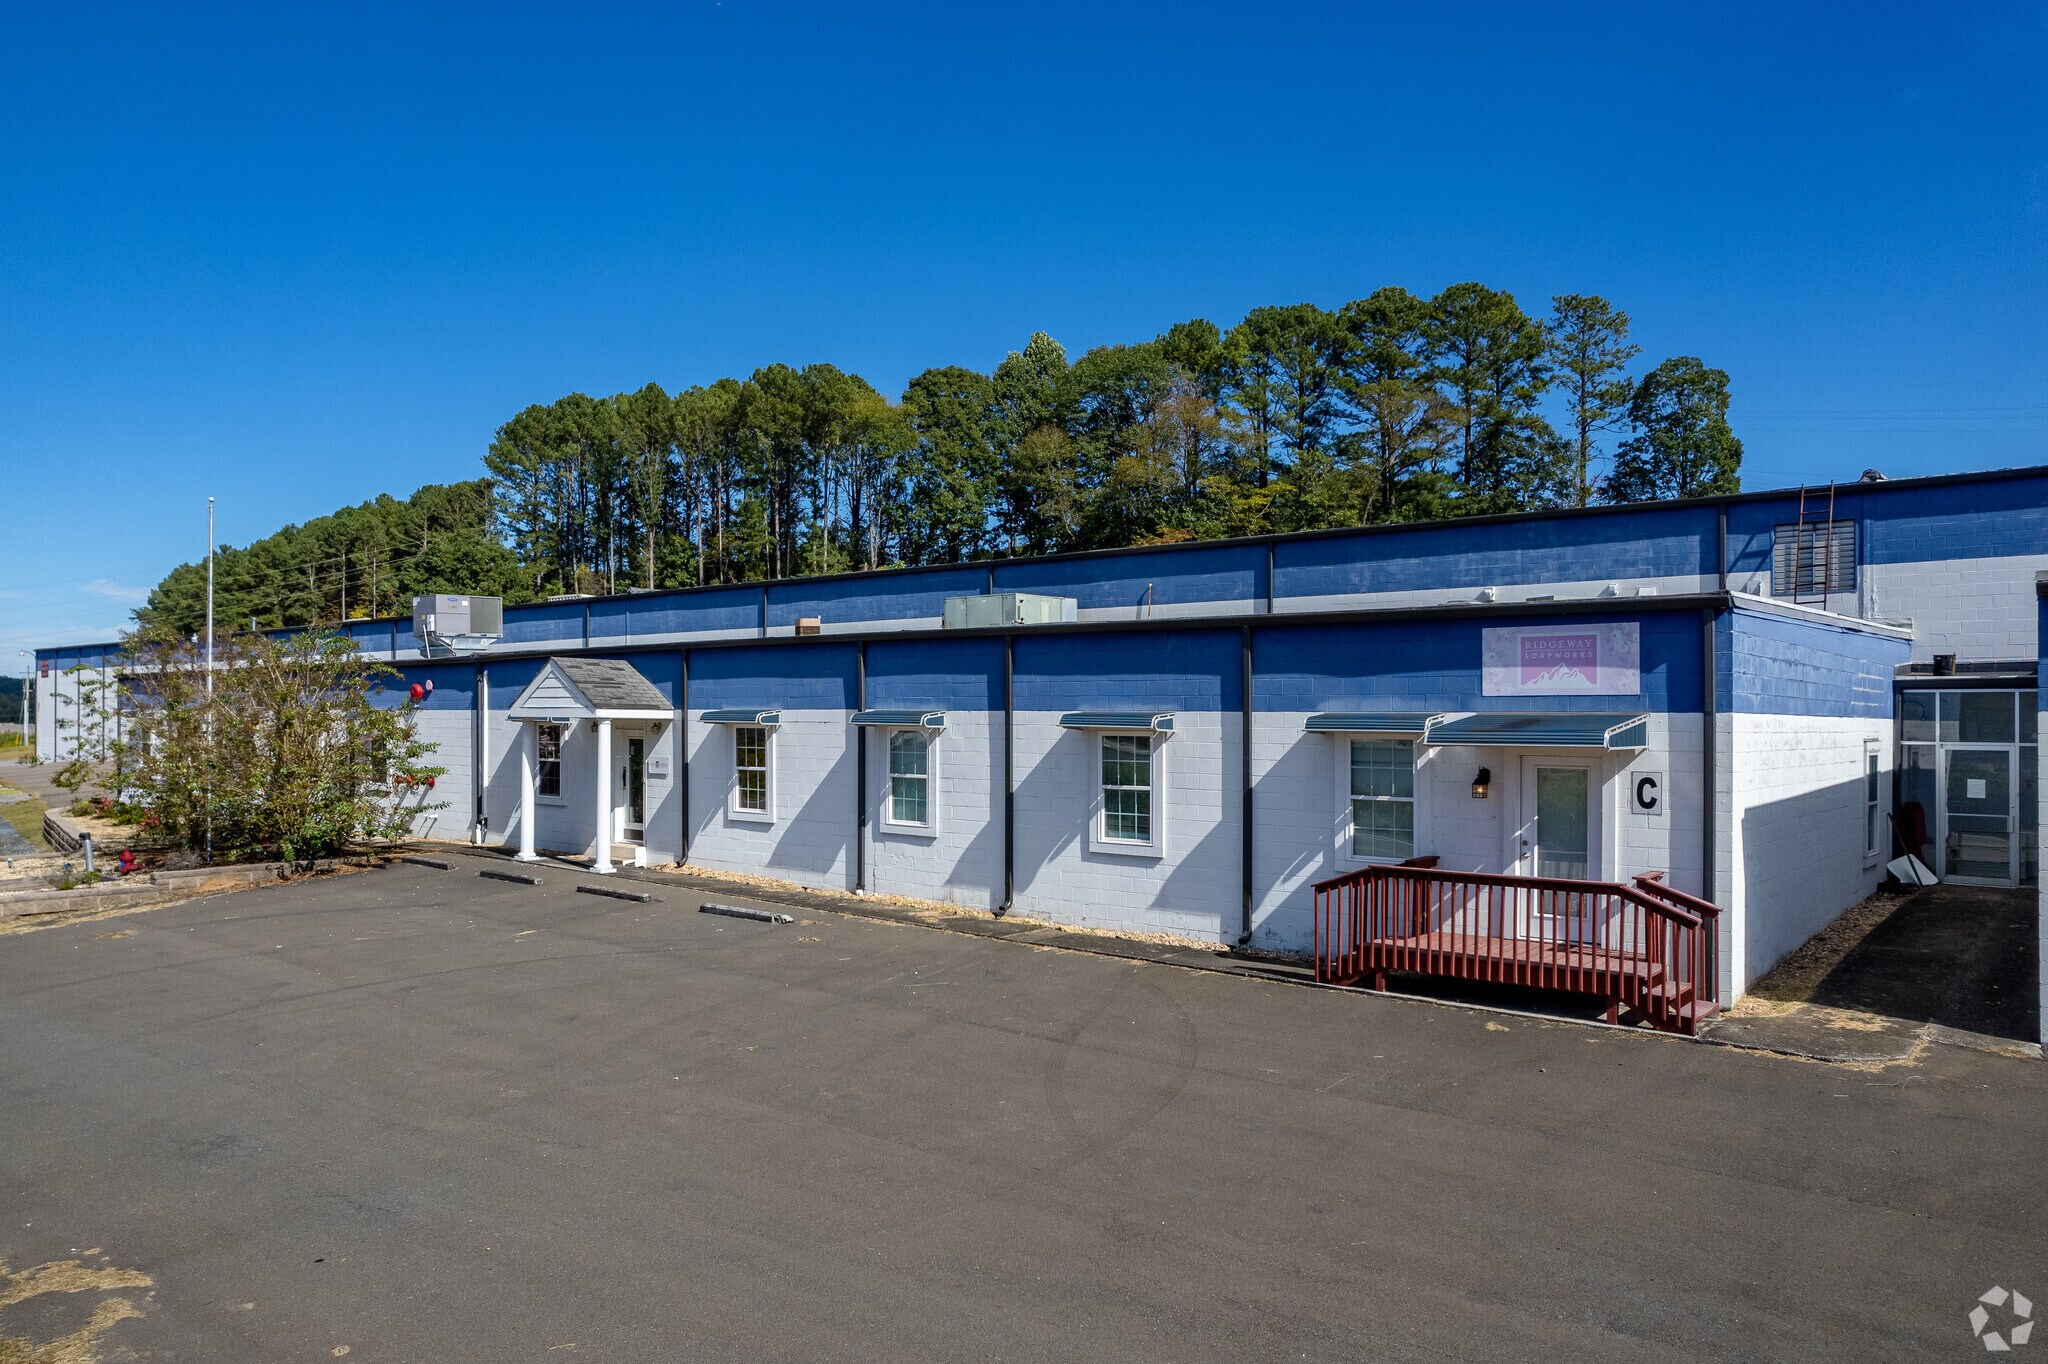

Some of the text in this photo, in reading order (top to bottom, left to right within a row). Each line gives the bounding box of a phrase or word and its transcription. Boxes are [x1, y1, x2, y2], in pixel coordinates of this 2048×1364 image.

[1524, 639, 1593, 649] RIDGEWAY
[1524, 651, 1593, 660] SOAPWORKS
[1636, 777, 1658, 810] C
